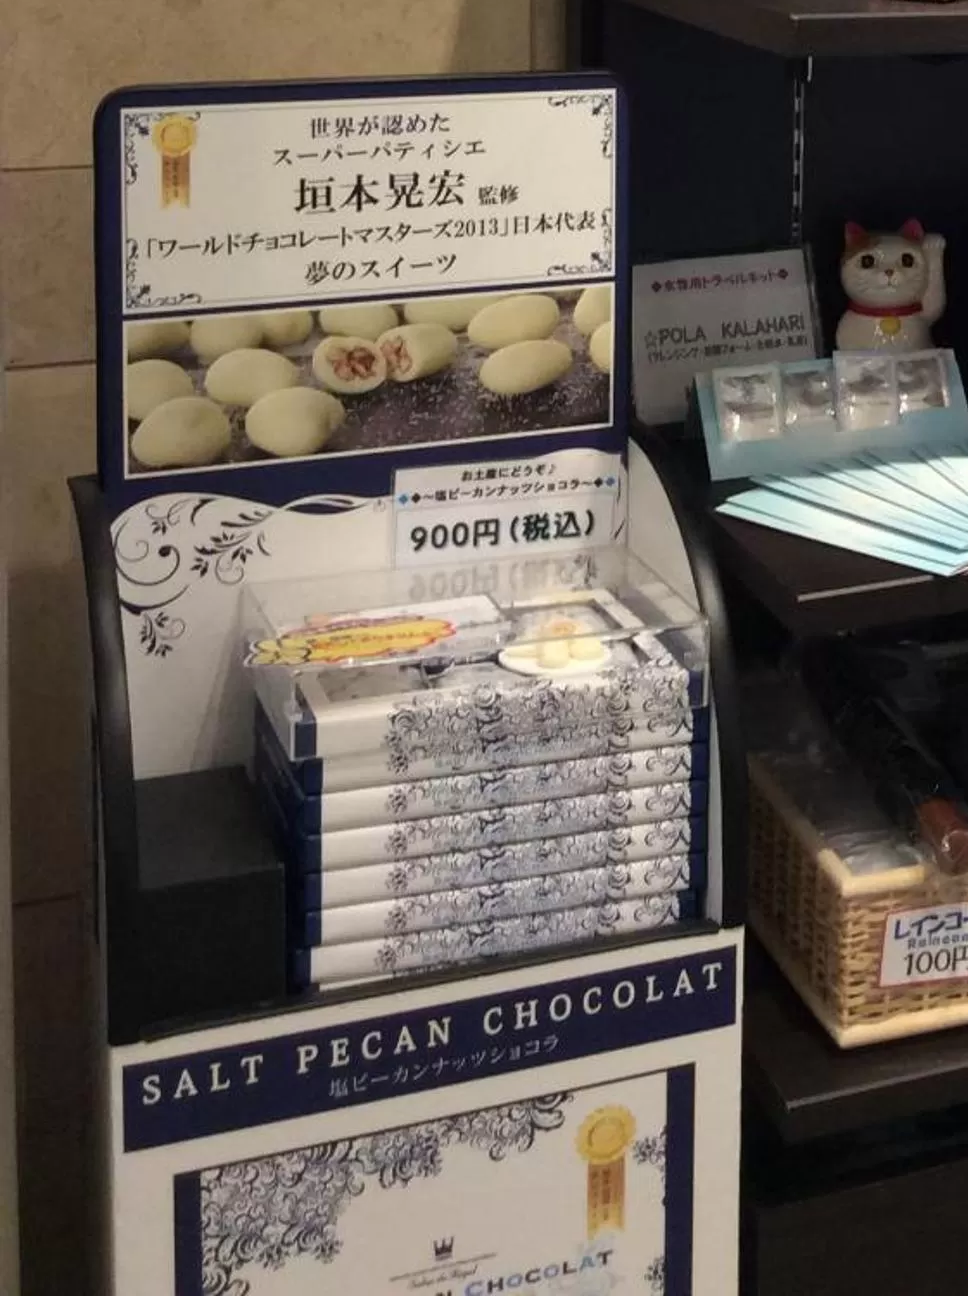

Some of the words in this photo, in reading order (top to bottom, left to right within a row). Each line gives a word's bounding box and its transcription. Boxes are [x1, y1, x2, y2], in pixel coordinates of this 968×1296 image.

[310, 112, 452, 139] 世界が認めた
[273, 139, 487, 166] スーパーパティシエ
[294, 169, 467, 215] 垣本晃宏
[478, 184, 520, 206] 監修
[304, 253, 458, 286] 夢のスイーツ
[658, 324, 707, 345] POLA
[721, 312, 806, 339] KALAHARI
[142, 1054, 264, 1106] SALT
[296, 1016, 452, 1075] PECAN
[483, 961, 723, 1036] CHOCOLAT
[329, 1034, 560, 1098] 塩ピーカンナッツショコラ
[464, 1250, 613, 1296] CHOCOLAT
